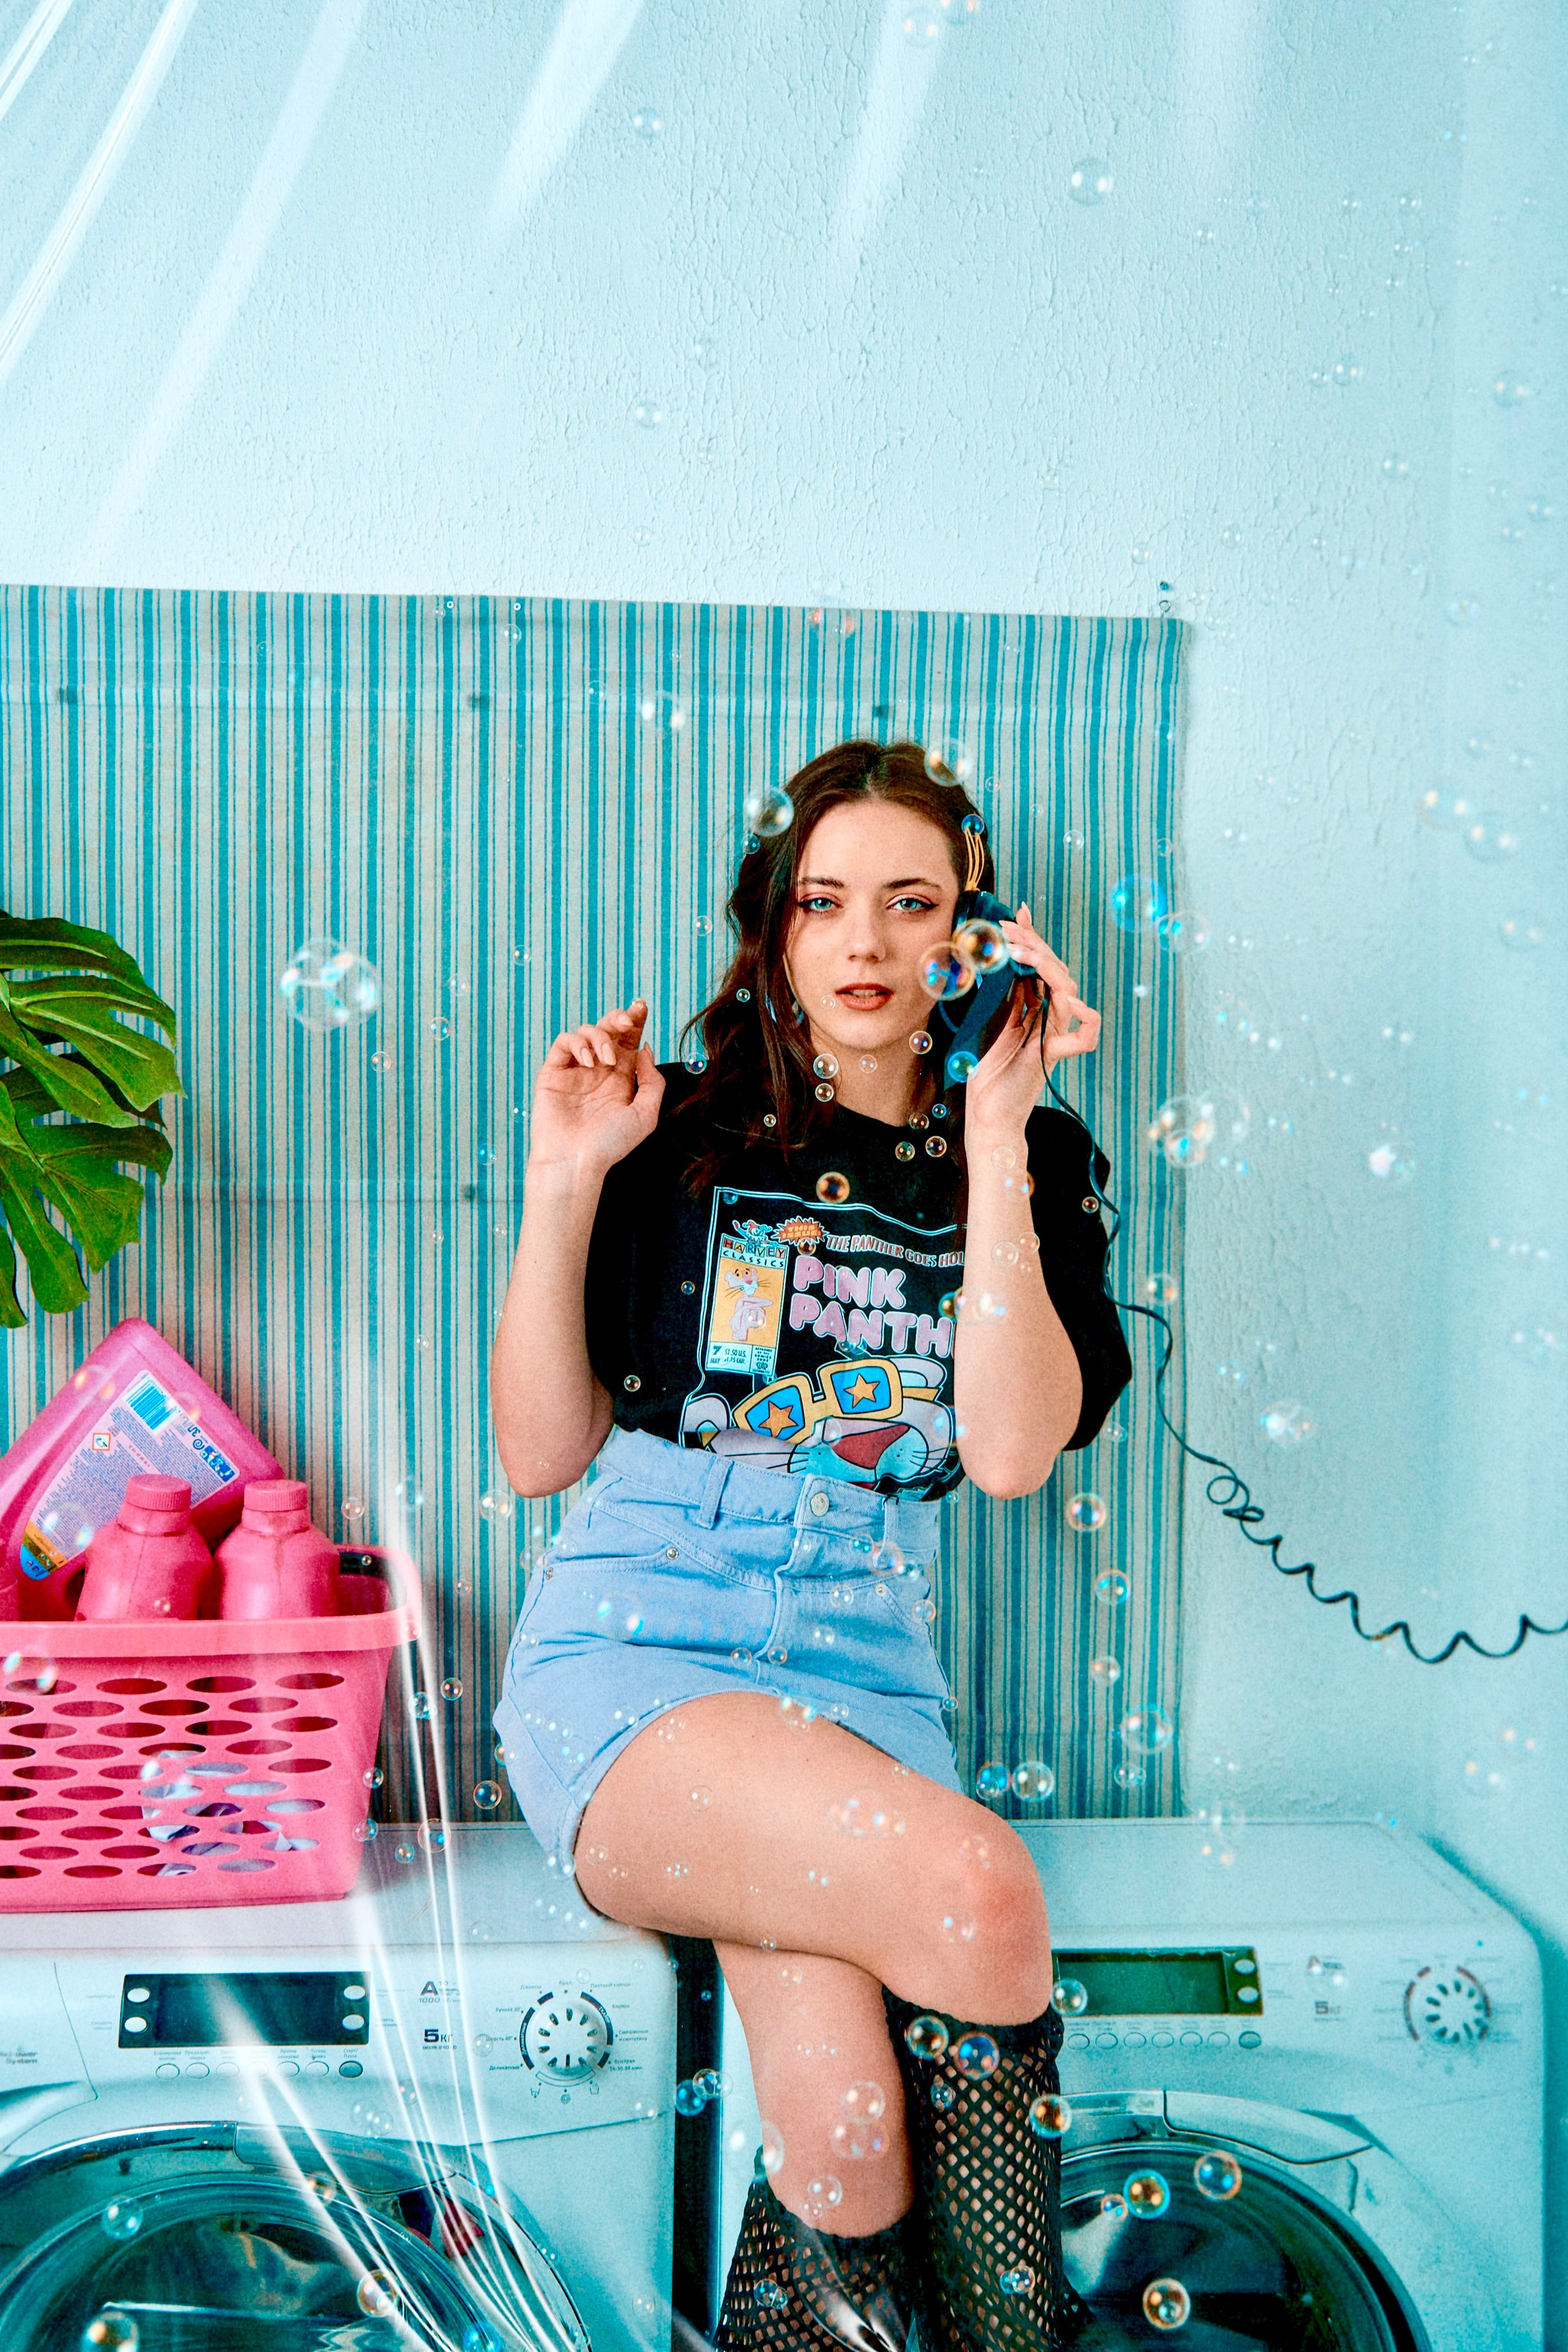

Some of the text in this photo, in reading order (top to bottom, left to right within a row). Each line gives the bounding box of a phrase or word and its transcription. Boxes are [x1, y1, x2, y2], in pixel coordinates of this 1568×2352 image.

[723, 1238, 786, 1259] HARVEY
[723, 1250, 784, 1267] CLASSICS
[826, 1235, 850, 1252] THE
[850, 1235, 903, 1258] PANTHER
[905, 1250, 937, 1267] GOES
[793, 1256, 907, 1309] PINK
[789, 1293, 956, 1359] PANTH
[713, 1345, 722, 1355] 7
[424, 2029, 439, 2043] 5
